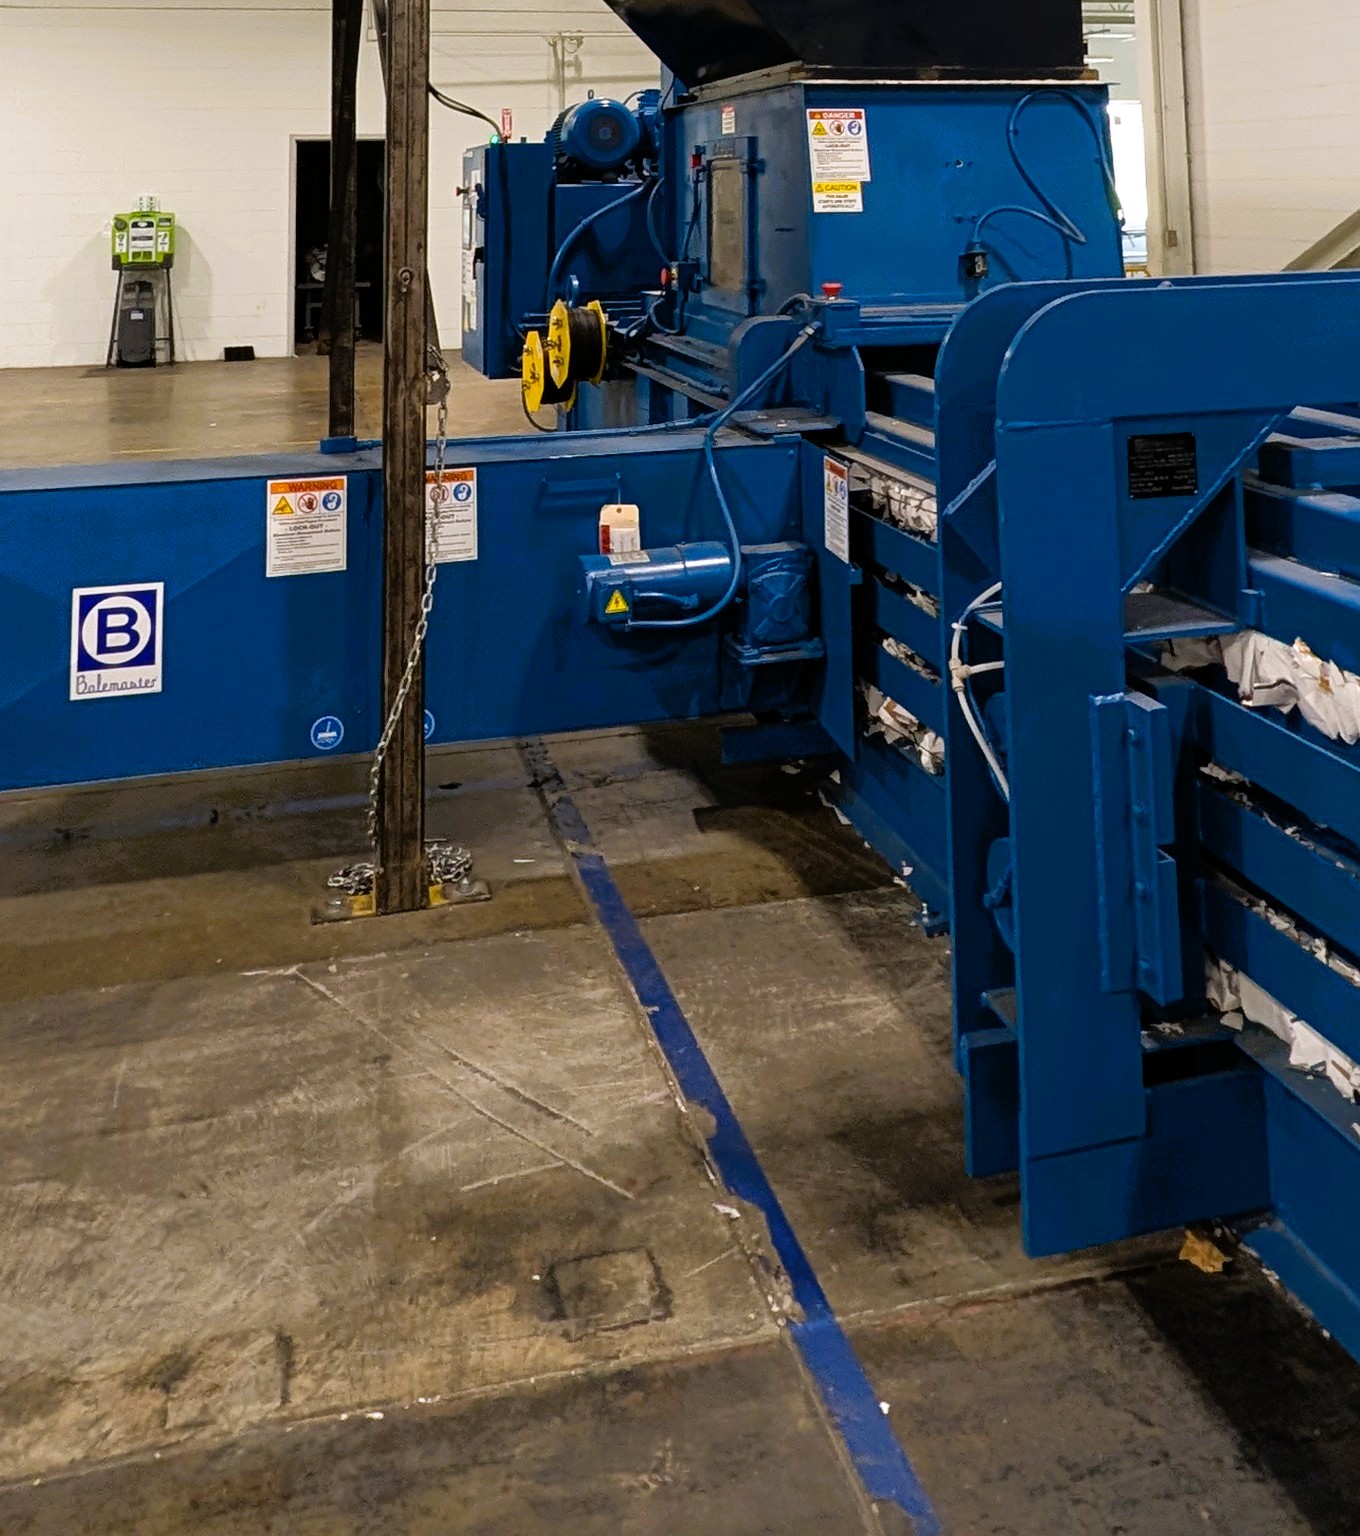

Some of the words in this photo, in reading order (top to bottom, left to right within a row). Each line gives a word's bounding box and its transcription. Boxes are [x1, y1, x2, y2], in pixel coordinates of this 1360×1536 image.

[825, 183, 857, 192] CAUTION
[288, 480, 339, 492] WARNING
[96, 607, 141, 655] B
[76, 674, 158, 695] Balemaster
